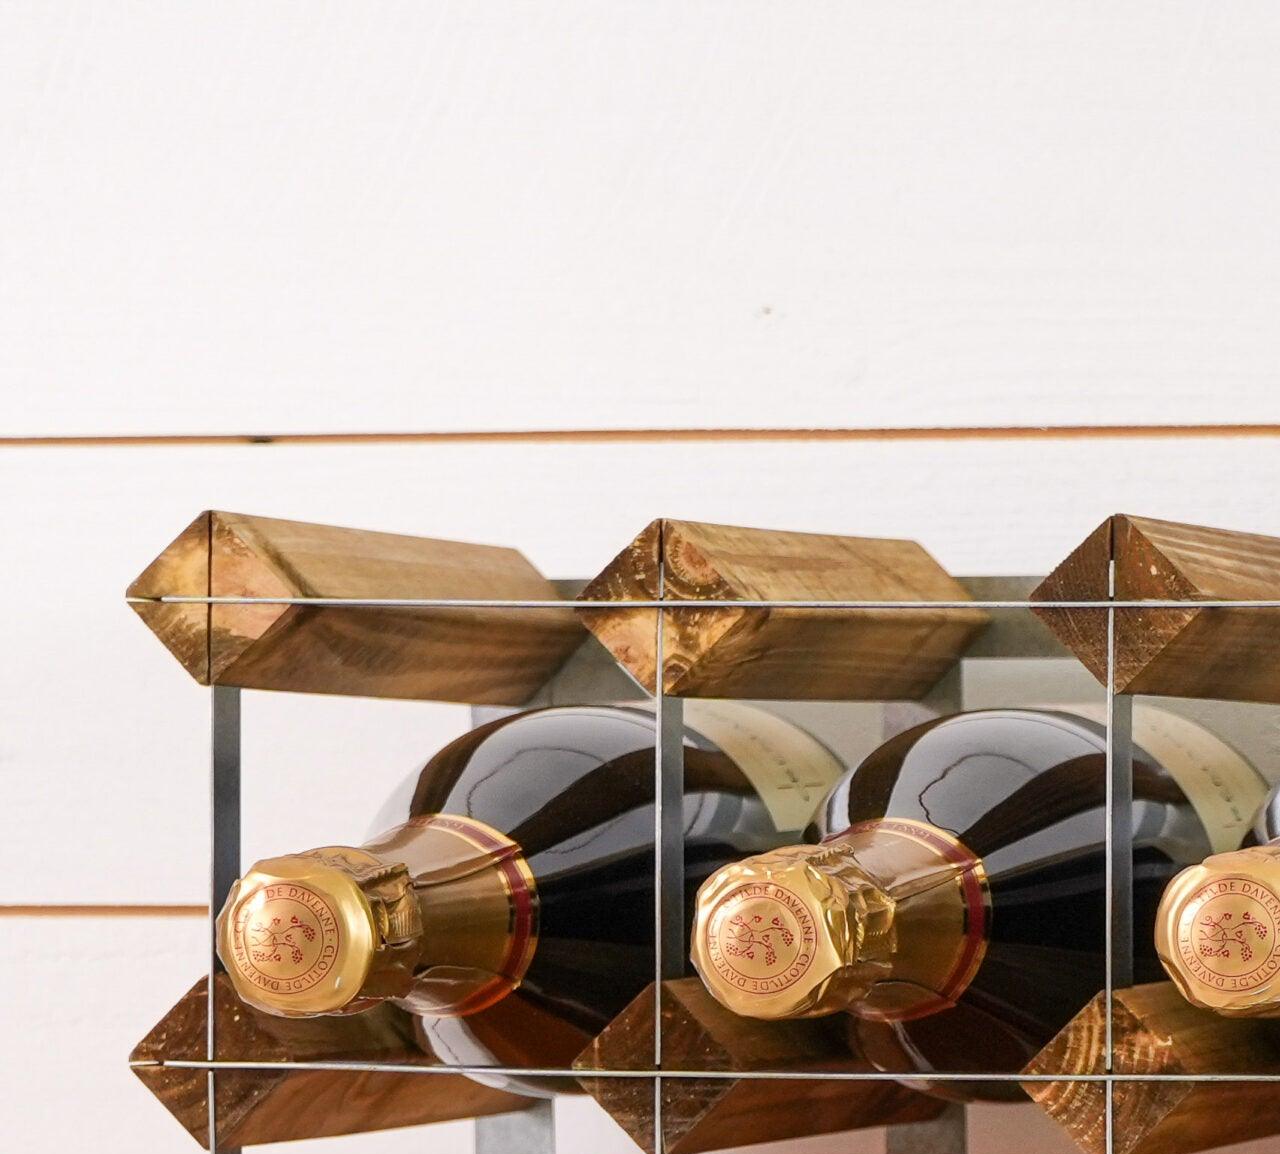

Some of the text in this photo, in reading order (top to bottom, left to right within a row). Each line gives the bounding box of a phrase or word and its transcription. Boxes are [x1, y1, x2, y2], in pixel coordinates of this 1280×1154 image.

[288, 887, 335, 934] DAVENNE
[775, 888, 814, 943] DAVENNE
[287, 945, 335, 990] CLOTILDE
[752, 953, 809, 990] CLOTILDE
